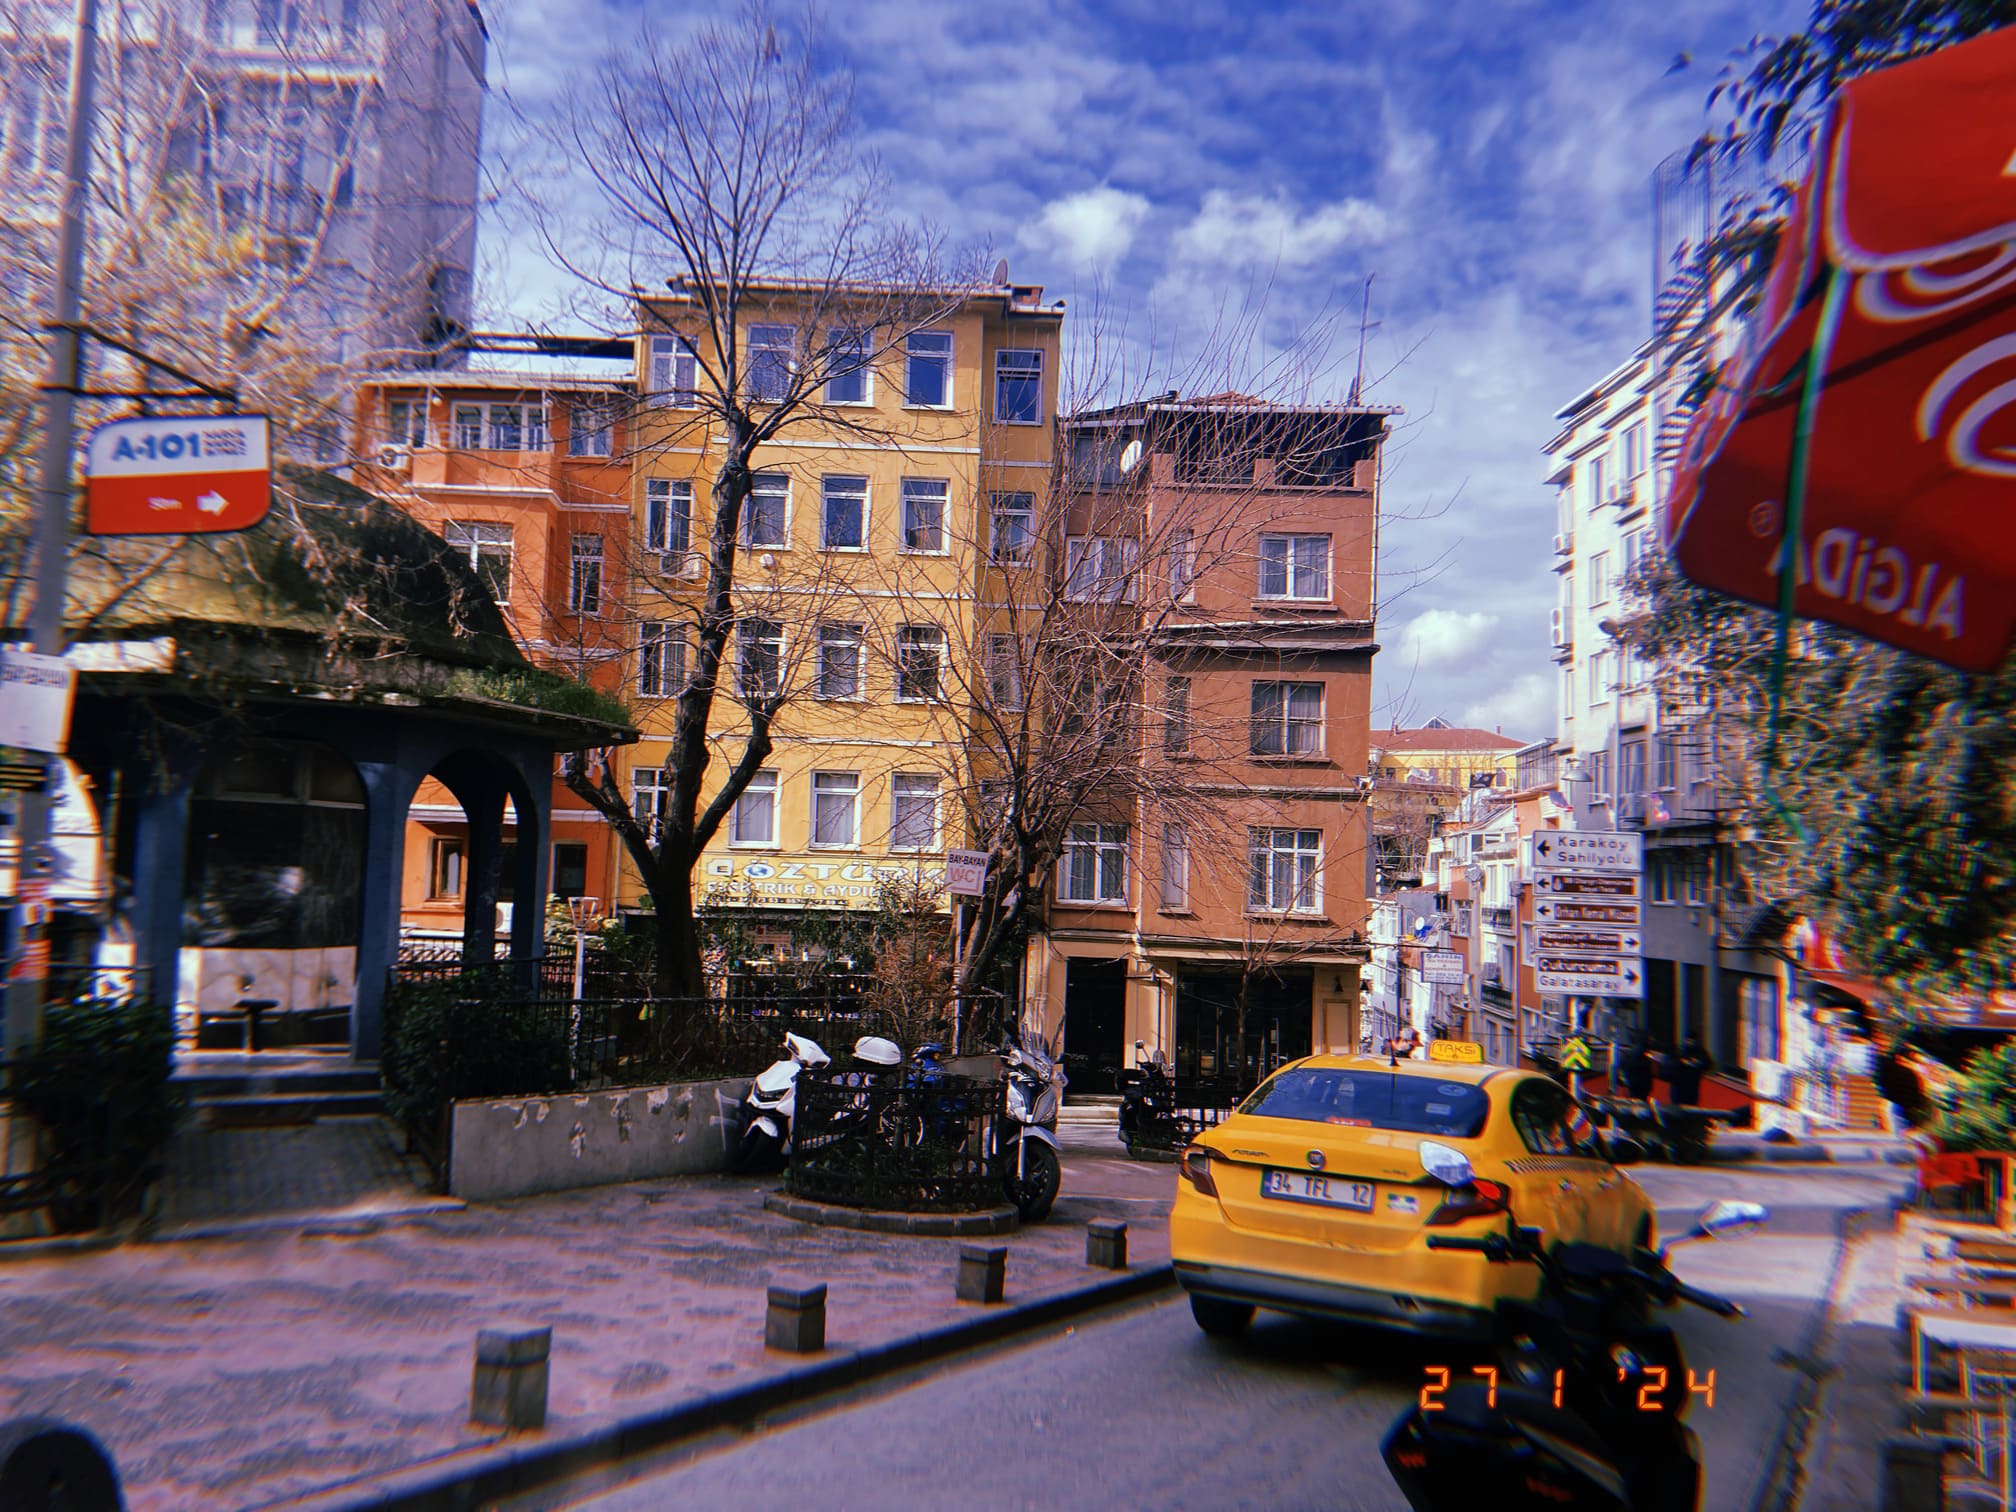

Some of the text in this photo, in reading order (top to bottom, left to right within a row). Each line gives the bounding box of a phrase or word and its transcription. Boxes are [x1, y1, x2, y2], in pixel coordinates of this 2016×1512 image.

[948, 853, 986, 867] BAY-BAYAN
[950, 867, 976, 883] WC
[1271, 1171, 1294, 1193] 34
[1303, 1176, 1334, 1200] TFL
[1351, 1183, 1371, 1205] 12
